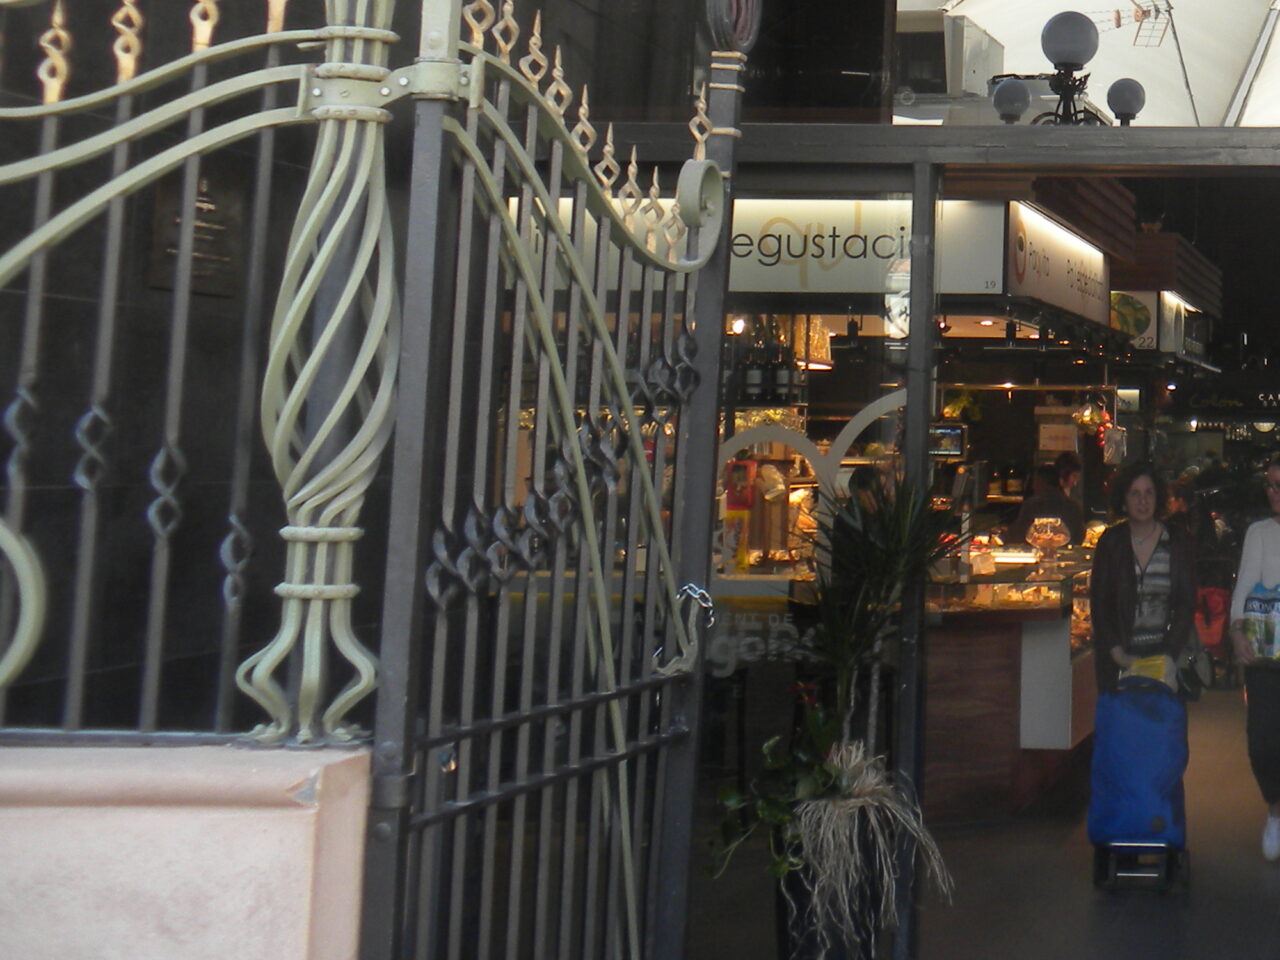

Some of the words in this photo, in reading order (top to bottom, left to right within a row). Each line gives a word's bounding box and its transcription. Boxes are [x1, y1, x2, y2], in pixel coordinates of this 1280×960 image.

[730, 226, 906, 266] egustaci
[984, 280, 997, 289] 19
[1138, 336, 1154, 348] 22
